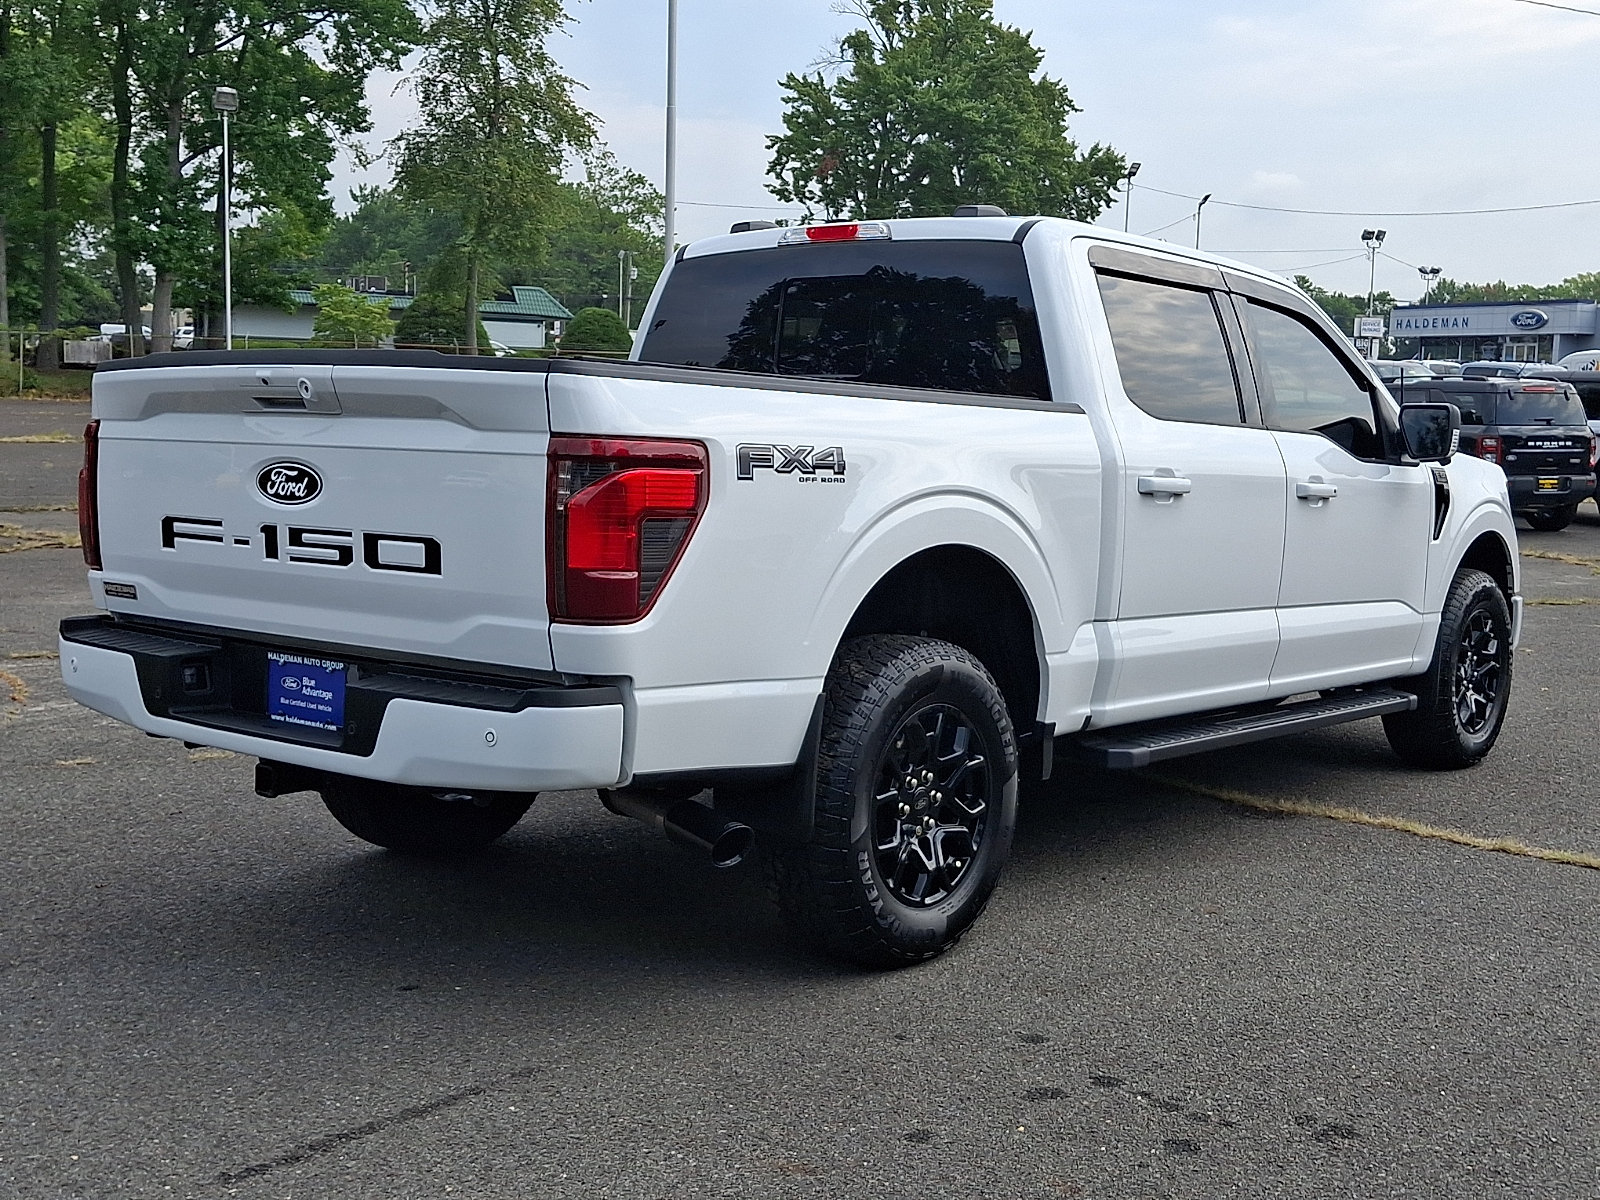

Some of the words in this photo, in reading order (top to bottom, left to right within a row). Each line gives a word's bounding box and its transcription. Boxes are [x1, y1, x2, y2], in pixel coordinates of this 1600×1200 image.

[1395, 317, 1470, 329] HALDEMAN
[735, 442, 846, 481] FX4
[266, 467, 308, 498] Ford
[160, 515, 444, 577] F-150
[268, 651, 303, 664] HALDEMAN
[304, 657, 320, 667] AUTO
[321, 660, 344, 670] GROUP
[302, 677, 316, 686] Blue
[302, 686, 333, 700] Advantage
[289, 699, 306, 707] Certified
[306, 701, 316, 710] Used
[317, 704, 333, 712] Vehicle
